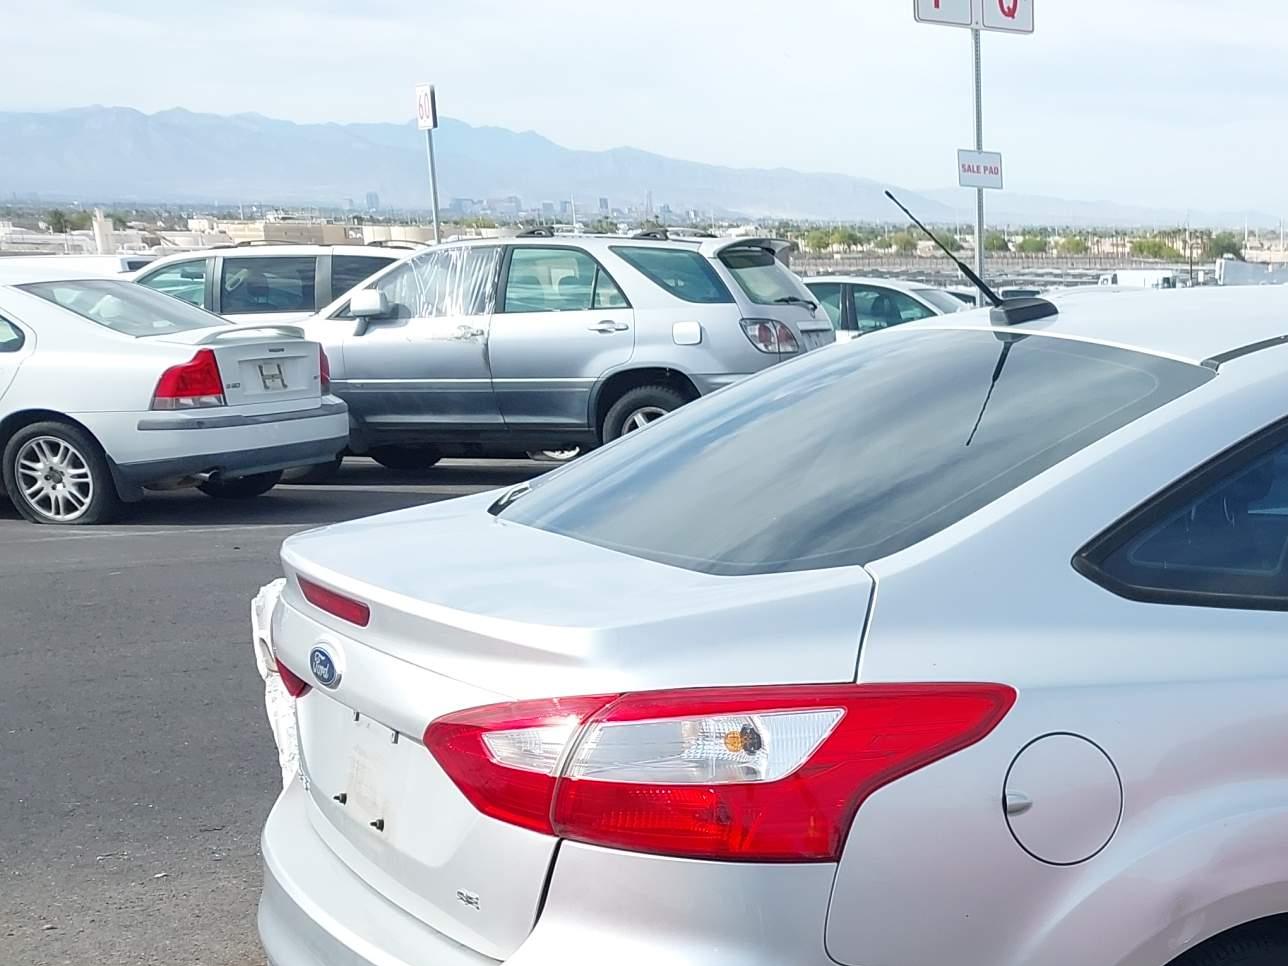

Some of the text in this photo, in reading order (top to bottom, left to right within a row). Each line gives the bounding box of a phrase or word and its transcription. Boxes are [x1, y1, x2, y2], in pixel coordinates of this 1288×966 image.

[961, 163, 999, 176] SALE PAD
[312, 651, 330, 680] Ford
